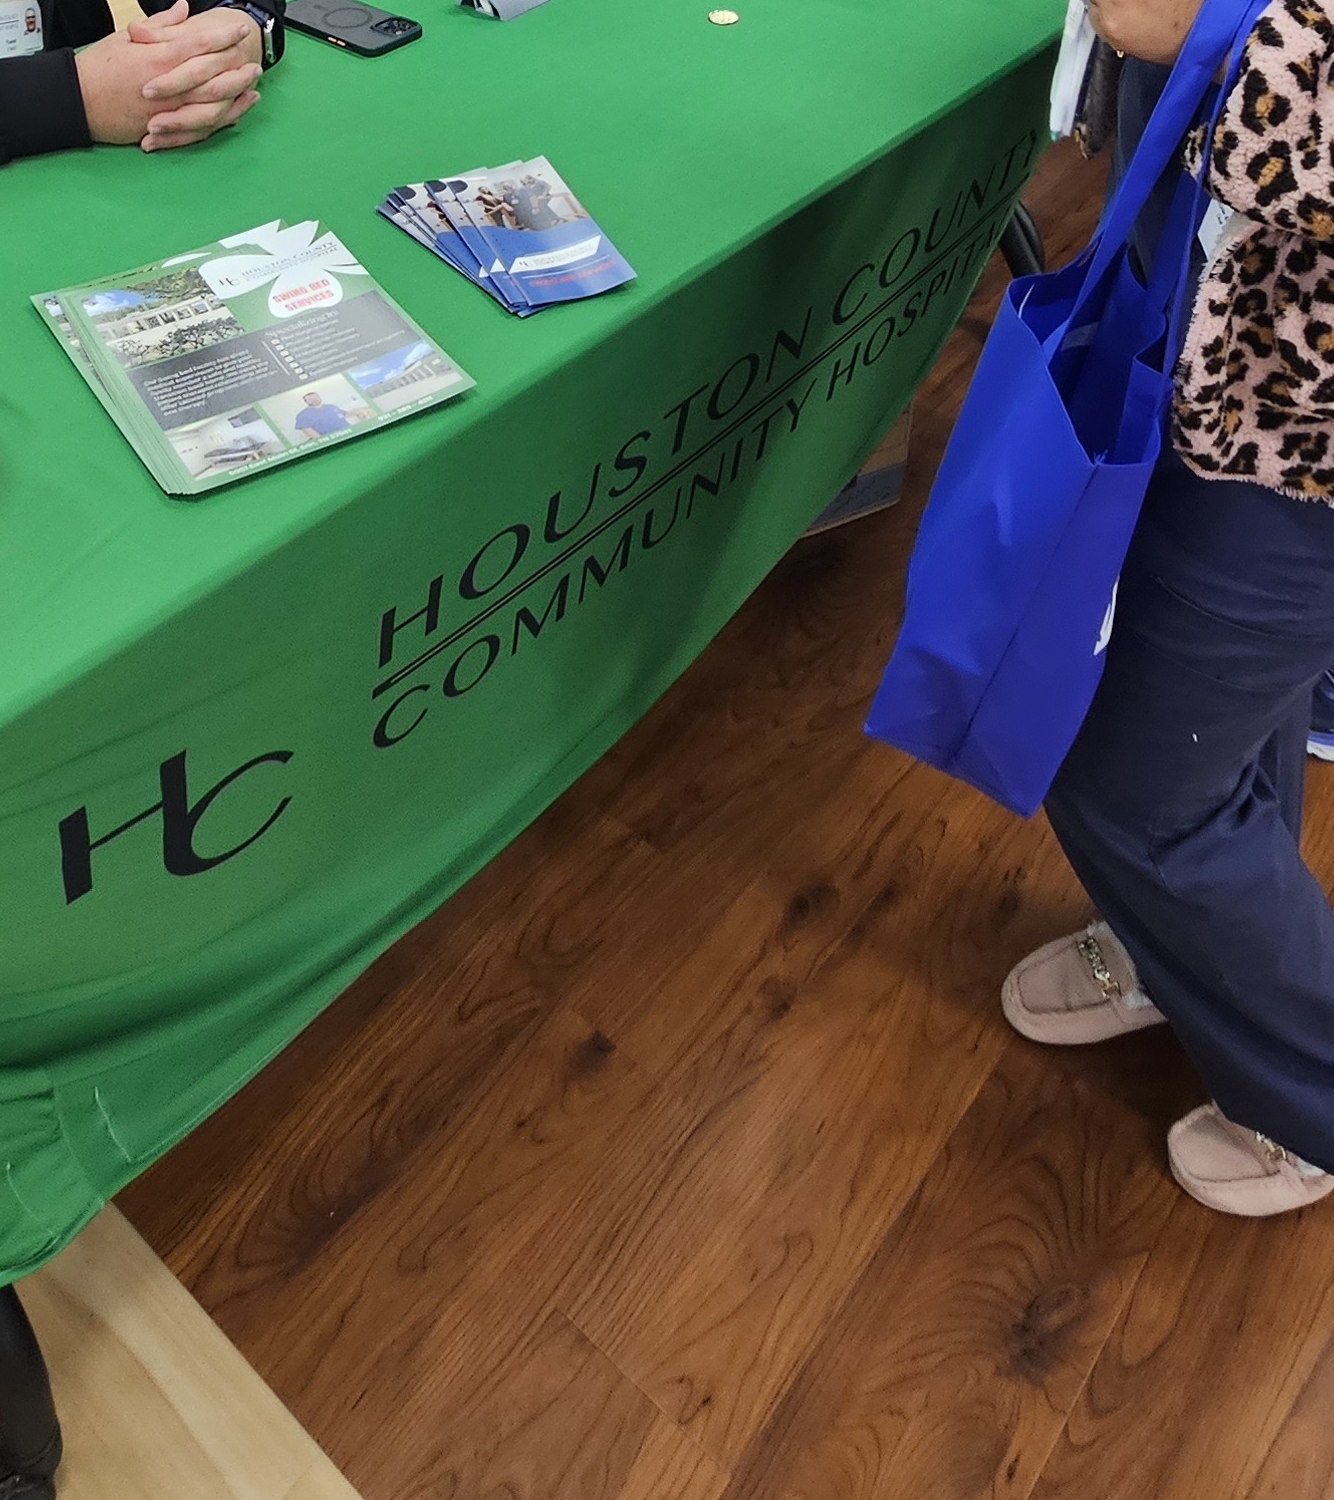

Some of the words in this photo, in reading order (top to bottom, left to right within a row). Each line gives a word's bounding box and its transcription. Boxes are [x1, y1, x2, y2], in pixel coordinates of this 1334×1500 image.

[273, 286, 308, 303] SWING
[309, 278, 331, 293] BED
[284, 289, 335, 312] SERVICES
[378, 307, 813, 669] HOUSTON
[832, 129, 1038, 326] COUNTY
[372, 378, 818, 748] COMMUNITY
[58, 748, 295, 906] HC
